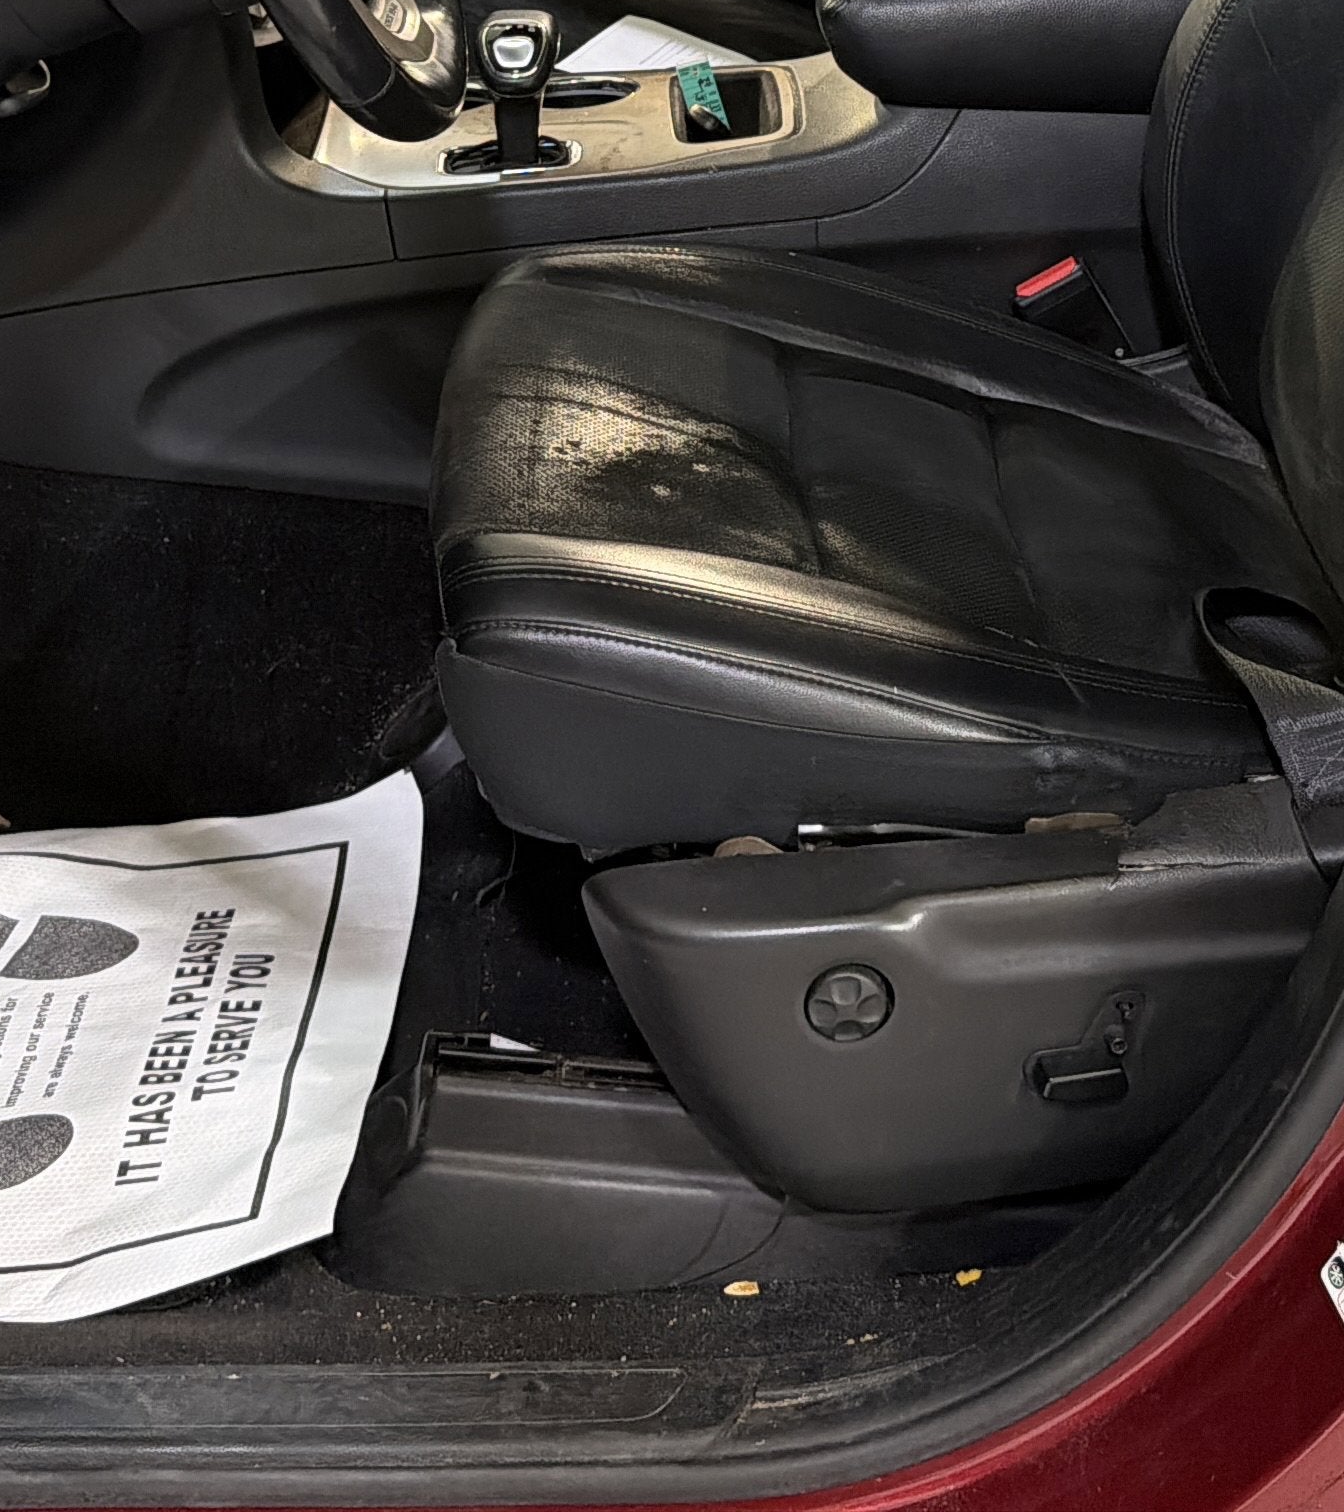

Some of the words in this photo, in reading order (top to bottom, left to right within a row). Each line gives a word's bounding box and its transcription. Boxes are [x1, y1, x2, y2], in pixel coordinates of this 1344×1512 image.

[167, 908, 236, 1006] PLEASURE
[224, 953, 276, 994] YOU
[0, 997, 18, 1012] for
[33, 991, 55, 1030] service
[64, 991, 90, 1041] welcome.
[161, 1007, 205, 1023] A
[26, 1032, 41, 1052] our
[203, 1000, 263, 1065] SERVE
[49, 1044, 74, 1079] always
[138, 1029, 198, 1086] BEEN
[0, 1055, 37, 1109] improving
[42, 1081, 58, 1098] are
[191, 1069, 240, 1102] TO
[123, 1091, 177, 1149] HAS
[114, 1159, 163, 1187] IT
